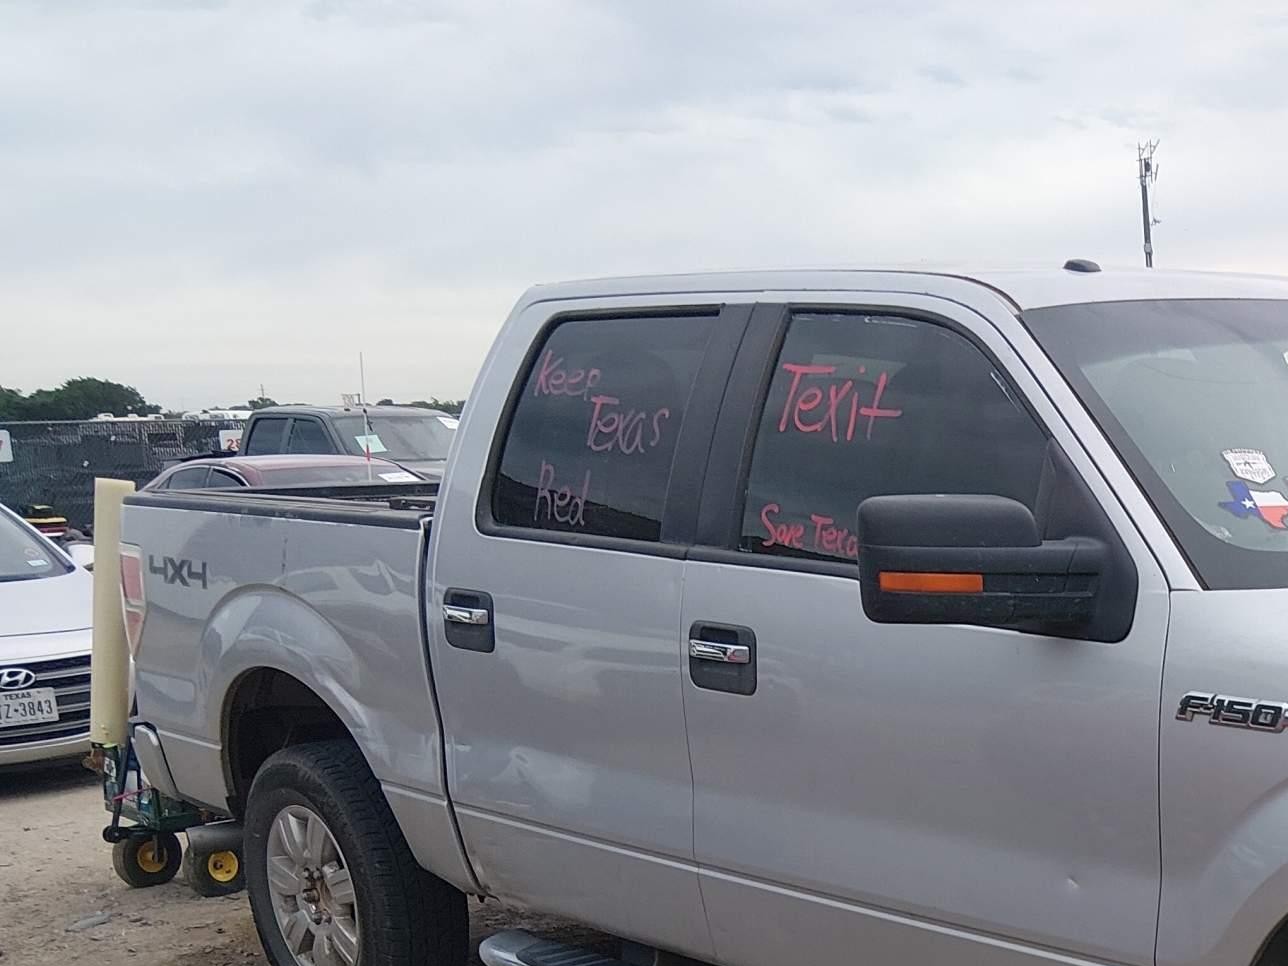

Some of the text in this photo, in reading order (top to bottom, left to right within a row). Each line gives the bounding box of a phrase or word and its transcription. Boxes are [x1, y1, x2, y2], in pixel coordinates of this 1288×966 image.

[534, 350, 601, 401] Keep
[779, 363, 903, 442] Texit
[587, 395, 669, 455] Texas
[534, 460, 591, 526] Red
[761, 503, 858, 557] Save Texa
[0, 699, 53, 720] Z-3843
[4, 691, 33, 701] TEXAS
